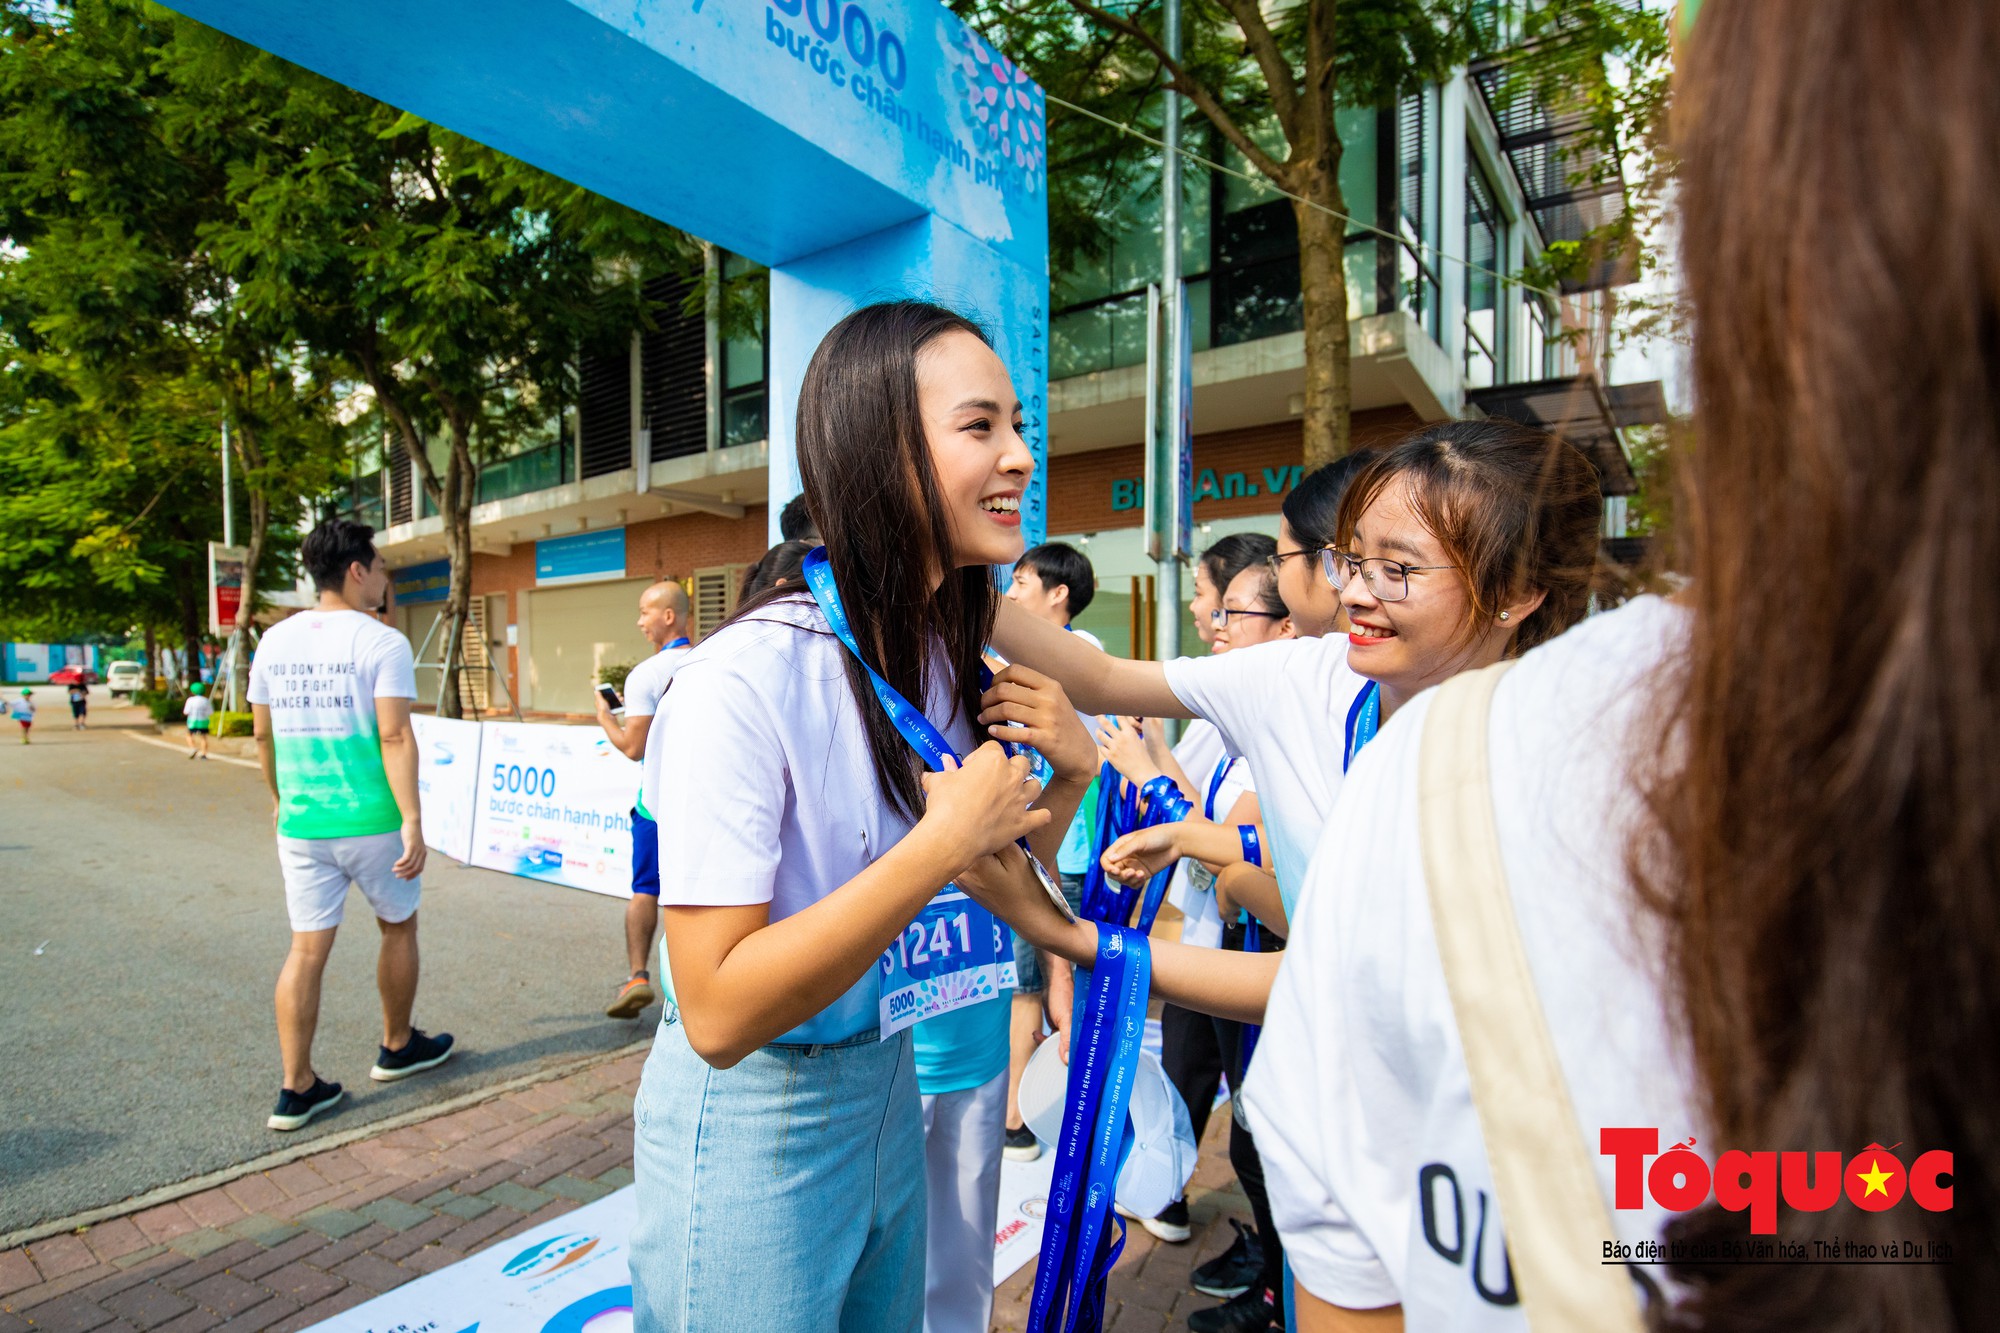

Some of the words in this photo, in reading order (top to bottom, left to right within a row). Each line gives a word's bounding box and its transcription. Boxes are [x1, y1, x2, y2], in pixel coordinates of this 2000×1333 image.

[766, 6, 846, 87] bước
[851, 73, 912, 132] chân
[1031, 305, 1042, 377] SALT
[1030, 394, 1042, 513] CANCER
[268, 664, 286, 676] YOU
[291, 663, 324, 676] DON'T
[327, 662, 356, 675] HAVE
[285, 680, 297, 692] TO
[302, 680, 334, 692] FIGHT
[270, 696, 310, 709] CANCER
[882, 694, 896, 709] 5000
[903, 716, 921, 733] SALT
[493, 763, 556, 798] 5000
[489, 796, 523, 816] bước
[526, 800, 560, 823] chân
[1101, 976, 1111, 993] NAM
[889, 990, 915, 1015] 5000
[1098, 994, 1107, 1011] VIỆT
[1095, 1012, 1104, 1027] THƯ
[1092, 1029, 1101, 1045] UNG
[1082, 1069, 1092, 1089] BỆNH
[1116, 1066, 1125, 1083] 5000
[1080, 1090, 1087, 1098] VÌ
[1078, 1100, 1086, 1111] BỘ
[1075, 1112, 1083, 1121] ĐI
[1073, 1122, 1081, 1136] HỘI
[1069, 1137, 1077, 1158] NGÀY
[1089, 1189, 1099, 1209] 5000
[1085, 1224, 1093, 1246] SALT
[1038, 1271, 1050, 1306] CANCER
[1047, 1223, 1060, 1269] INITIATIVE
[1076, 1248, 1087, 1284] CANCER
